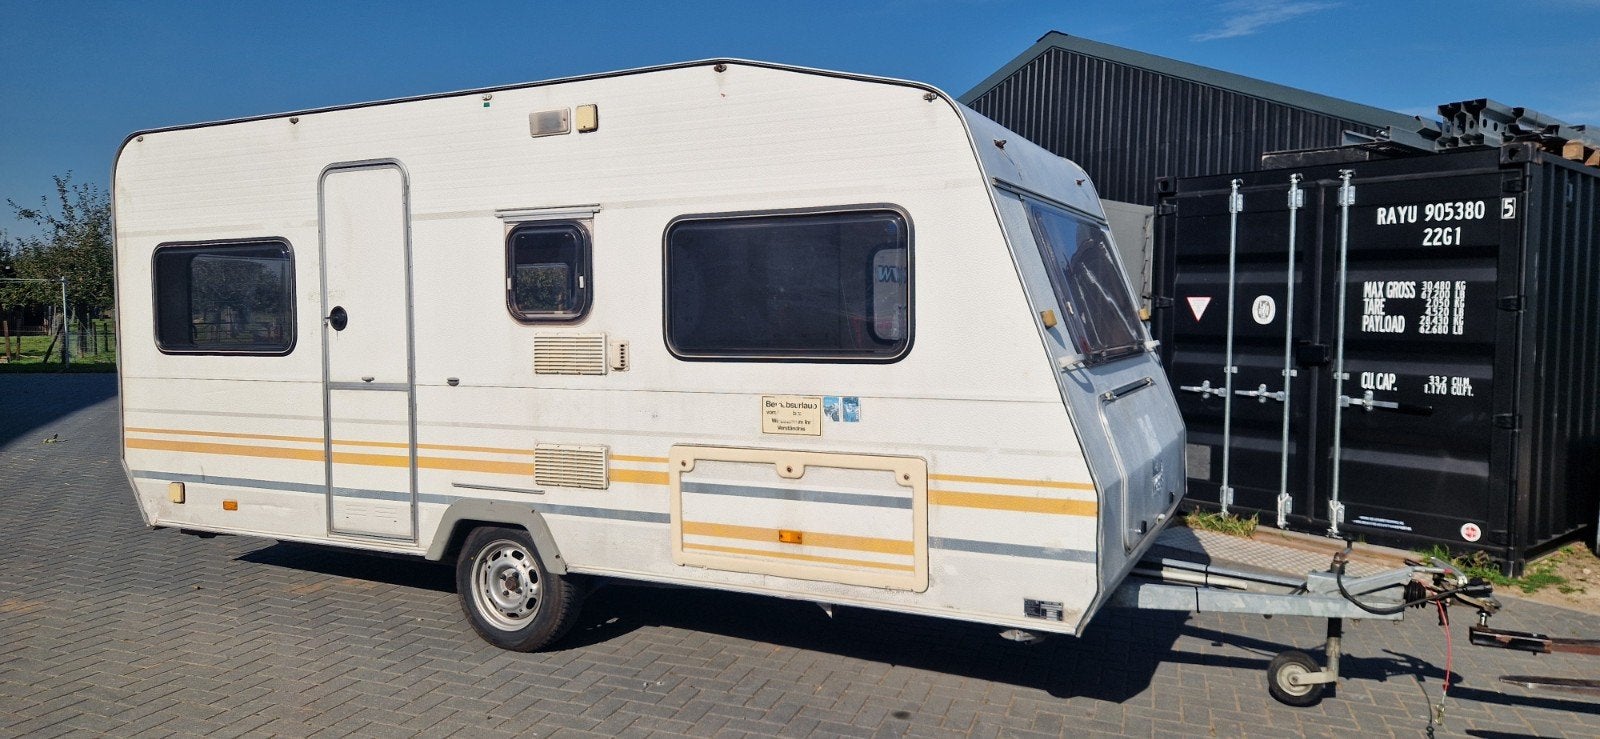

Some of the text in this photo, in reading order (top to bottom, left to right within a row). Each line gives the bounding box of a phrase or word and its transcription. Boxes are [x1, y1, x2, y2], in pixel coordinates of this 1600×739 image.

[1377, 199, 1514, 225] RAYU 905380 5
[1422, 227, 1461, 246] 22G1
[1363, 281, 1466, 298] MAX GROSS 30.480 KG
[1455, 290, 1465, 299] LB
[1363, 298, 1386, 315] TARE
[1454, 298, 1465, 308] KG
[1454, 308, 1464, 317] LB
[1362, 315, 1405, 333] PAYLOAD
[1453, 316, 1464, 326] KG
[1452, 325, 1463, 335] LB
